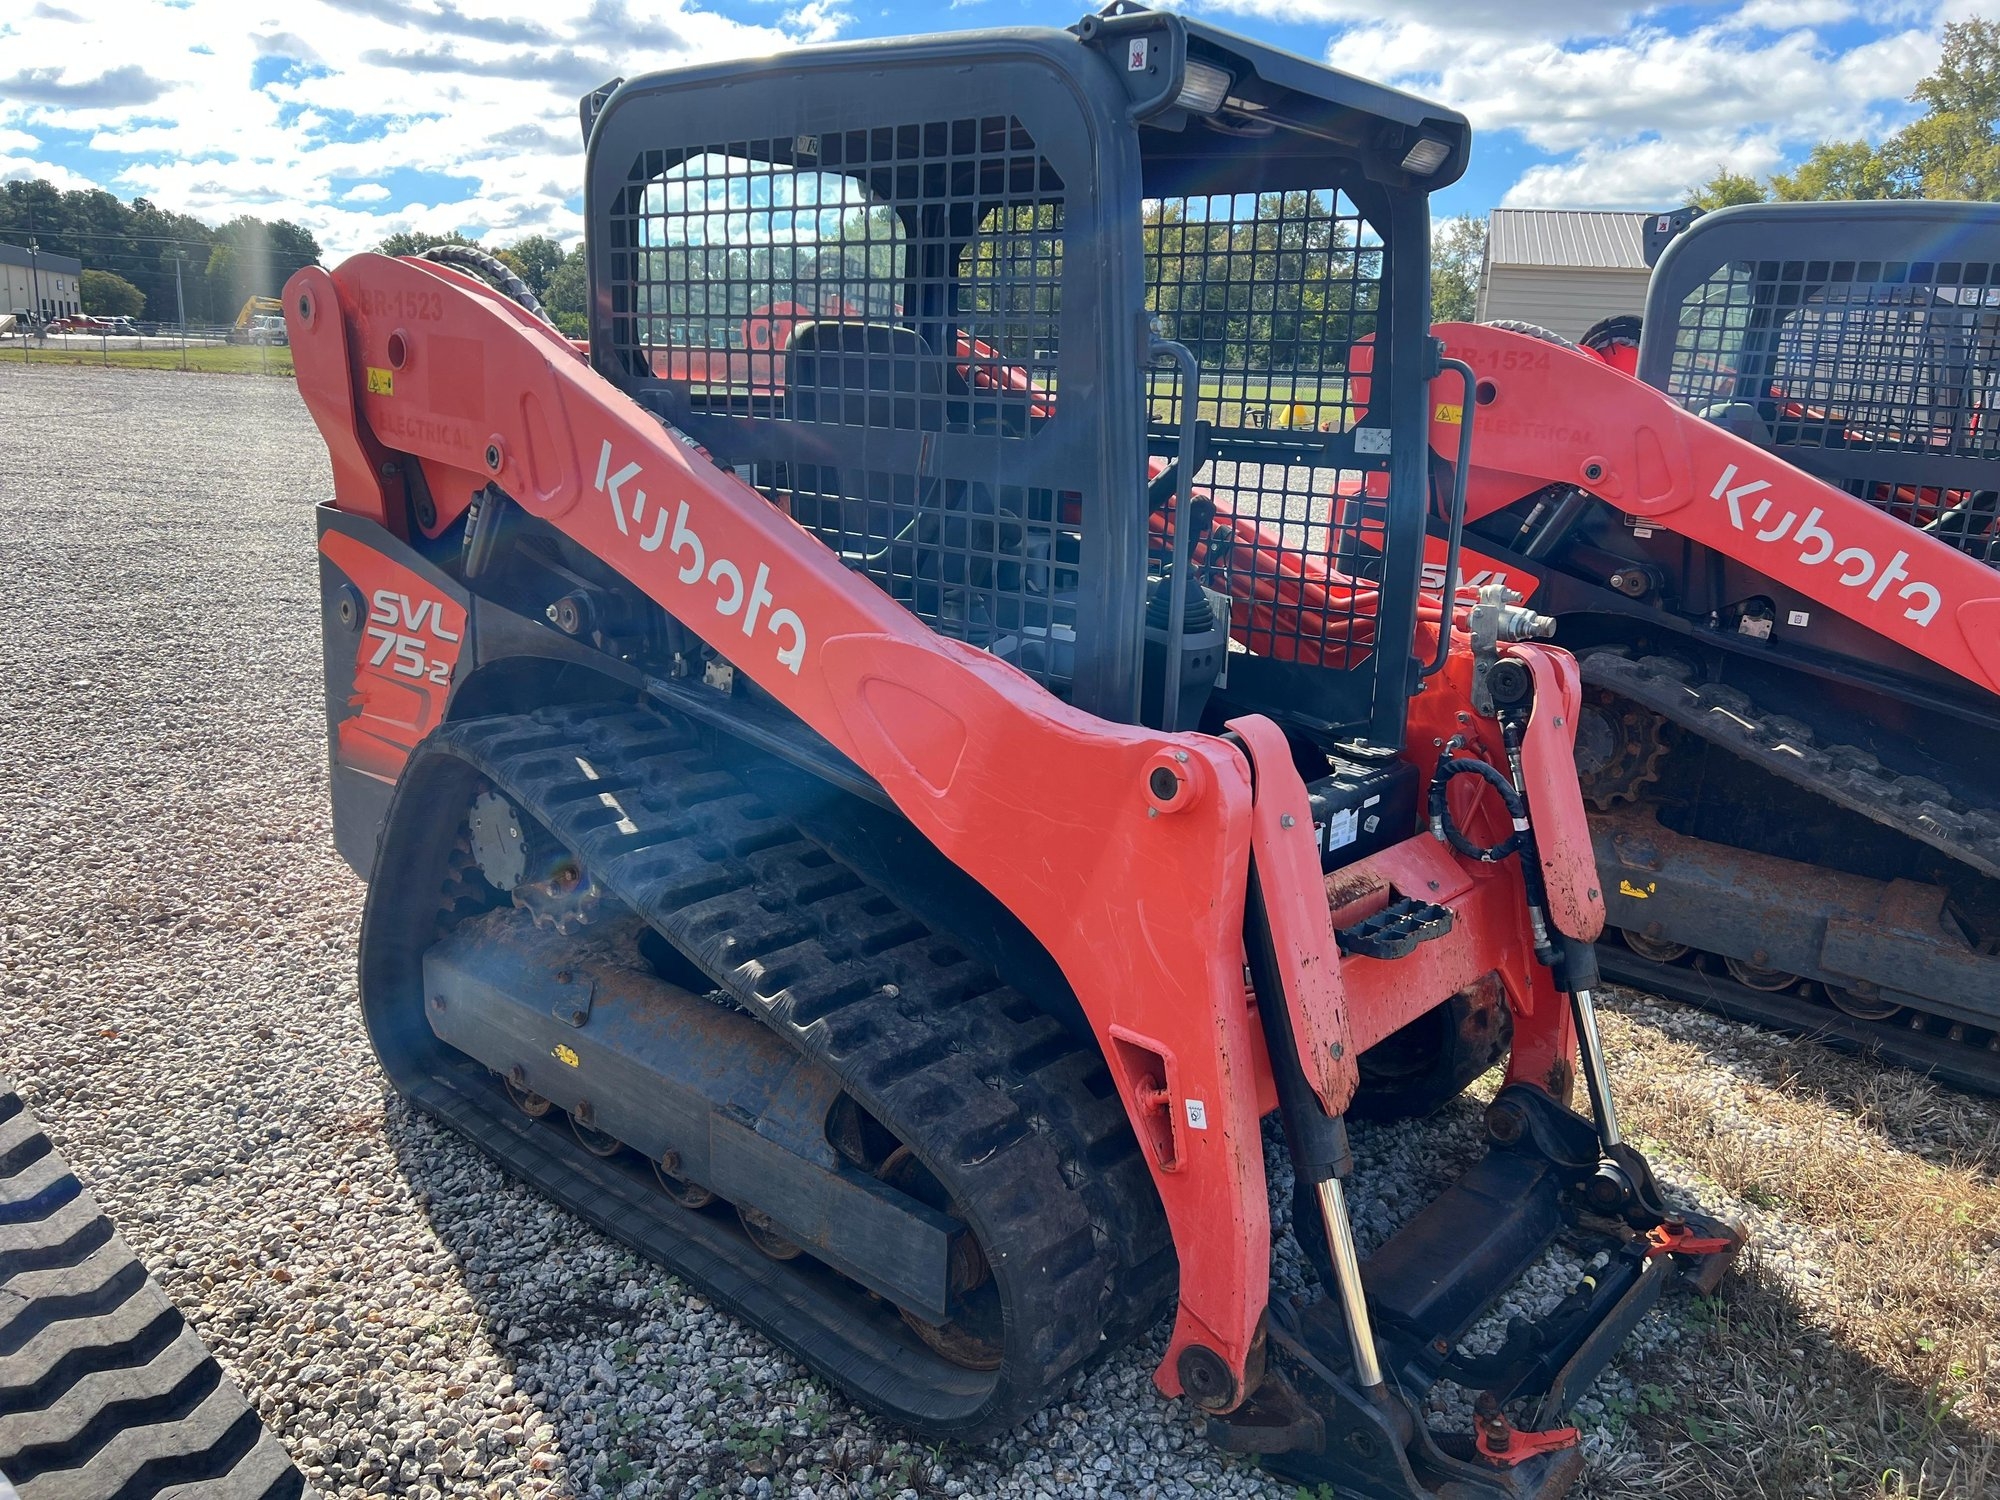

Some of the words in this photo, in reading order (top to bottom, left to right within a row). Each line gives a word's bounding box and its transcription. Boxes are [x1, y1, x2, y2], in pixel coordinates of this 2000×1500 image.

[360, 289, 443, 321] BR-1523
[379, 411, 473, 449] ELECTRICAL
[594, 439, 807, 676] Kubota
[1709, 463, 1942, 627] Kubota
[370, 590, 459, 643] SVL
[367, 626, 450, 686] 75-2
